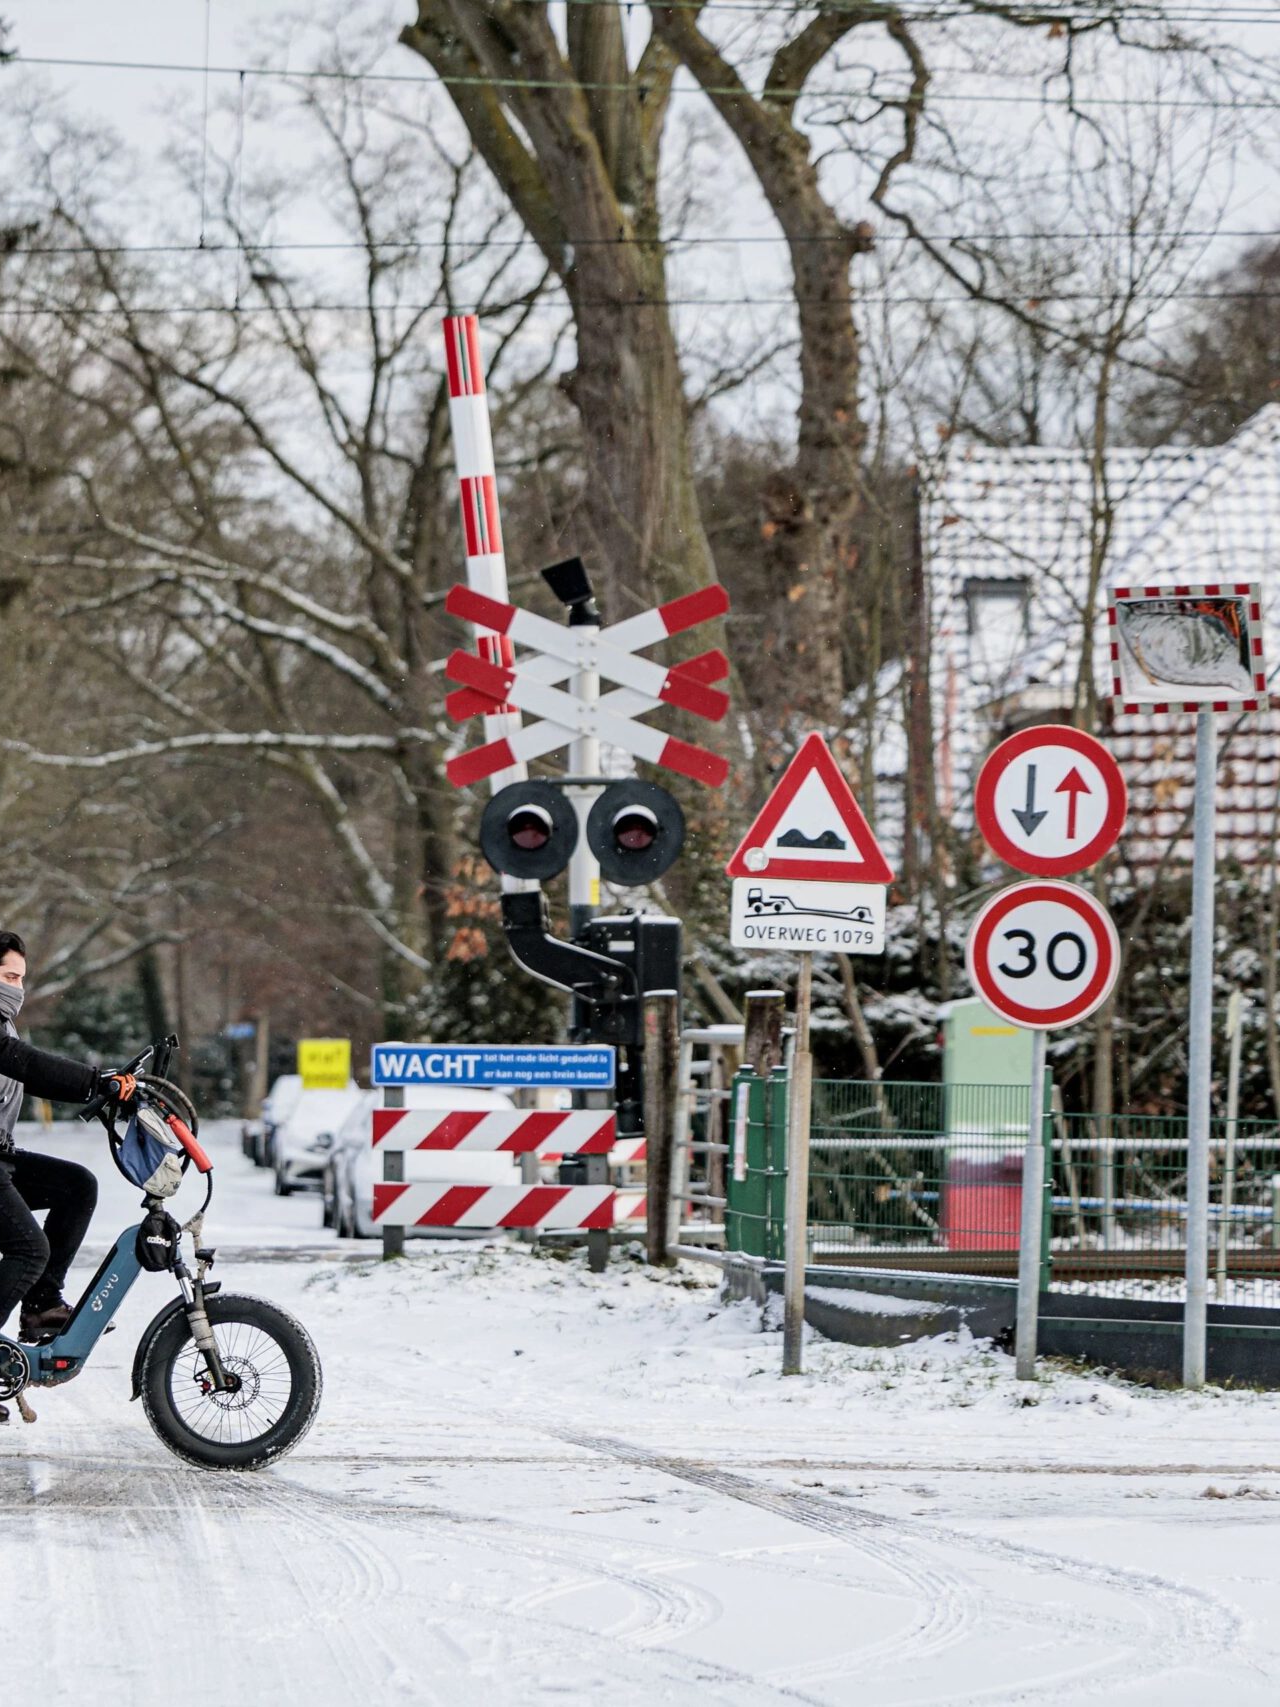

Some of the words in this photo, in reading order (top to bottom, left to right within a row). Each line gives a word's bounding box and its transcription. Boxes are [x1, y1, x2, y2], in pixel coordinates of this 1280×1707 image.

[744, 925, 827, 942] OVERWEG
[834, 930, 874, 945] 1079
[998, 928, 1087, 982] 30
[378, 1053, 481, 1078] WACHT
[483, 1054, 497, 1063] tot
[499, 1054, 514, 1063] het
[516, 1054, 537, 1063] rode
[538, 1054, 559, 1063] licht
[561, 1054, 598, 1066] gedoofd
[600, 1055, 608, 1064] is
[483, 1071, 494, 1079] er
[496, 1069, 512, 1079] kan
[515, 1070, 532, 1081] nog
[534, 1071, 551, 1079] een
[552, 1069, 575, 1079] trein
[577, 1069, 608, 1080] komen
[102, 1273, 120, 1298] DYU
